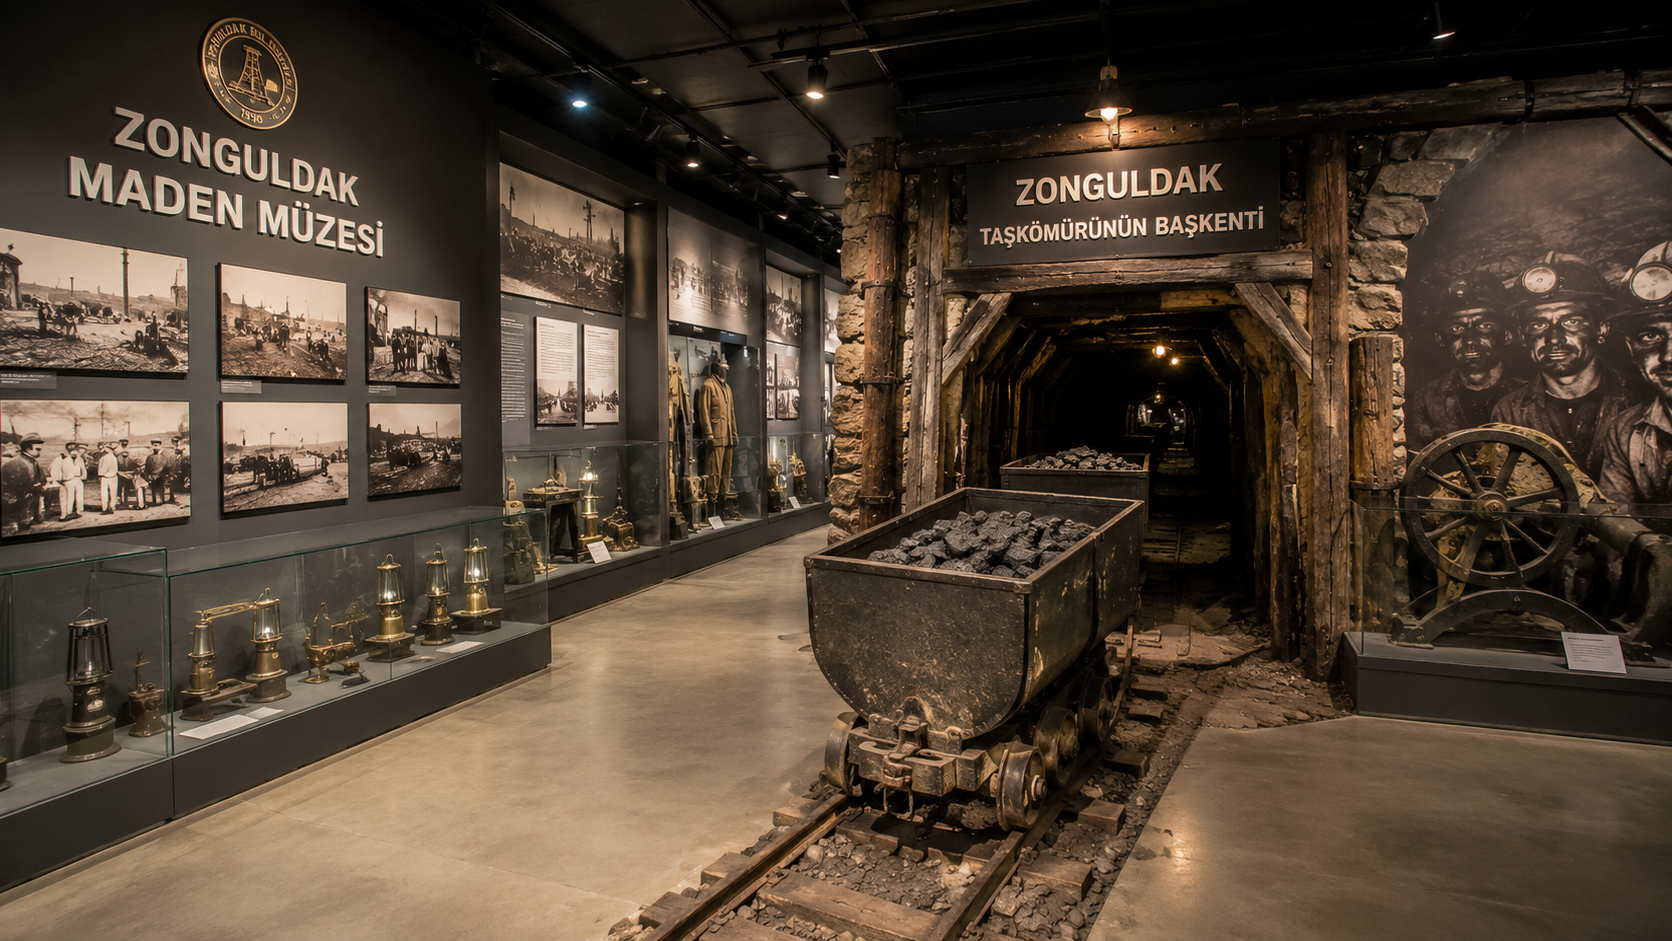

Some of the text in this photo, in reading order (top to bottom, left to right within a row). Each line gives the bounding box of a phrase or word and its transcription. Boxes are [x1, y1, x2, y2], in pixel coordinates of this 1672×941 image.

[114, 106, 359, 207] ZONGULDAK
[1016, 163, 1223, 206] ZONGULDAK
[68, 155, 384, 257] MADEN MÜZESİ
[980, 206, 1264, 248] TAŞKÖMÜRÜNÜN BAŞKENTİ
